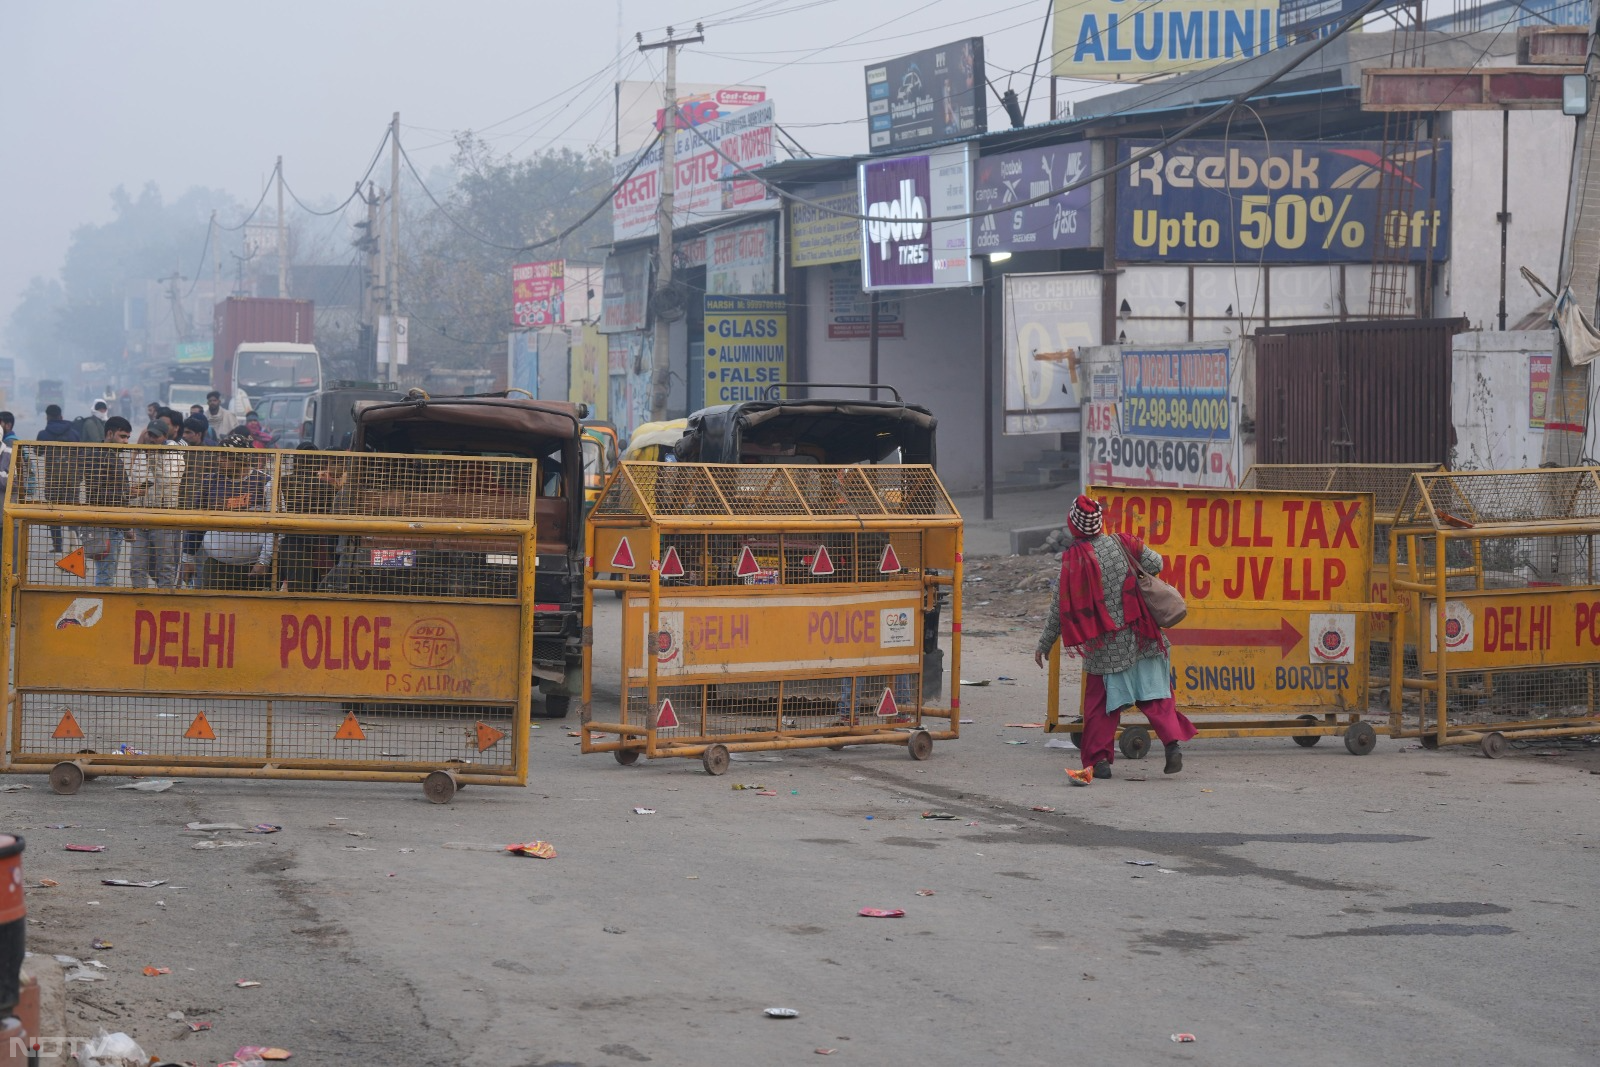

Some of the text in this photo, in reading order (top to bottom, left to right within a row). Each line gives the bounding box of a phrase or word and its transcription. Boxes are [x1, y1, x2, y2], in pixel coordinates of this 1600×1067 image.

[1001, 158, 1023, 178] Reebok
[1129, 147, 1319, 195] Reebok
[976, 188, 999, 202] campus
[868, 179, 925, 261] apollo
[1132, 209, 1220, 255] Upto
[1240, 194, 1365, 250] 50%
[977, 231, 1000, 248] adidas
[899, 244, 928, 265] TYRES
[707, 300, 734, 309] HARSH
[719, 319, 778, 338] GLASS
[719, 345, 784, 362] ALUMINIUM
[720, 367, 780, 382] FALSE
[1123, 354, 1141, 388] VIP
[1141, 354, 1180, 388] MOBILE
[1181, 352, 1227, 389] NUMBER
[720, 386, 780, 401] CEILING
[1097, 495, 1362, 549] MCD TOLL TAX
[1223, 556, 1274, 601] JV
[1282, 557, 1347, 601] LLP
[133, 609, 392, 671] DELHI POLICE
[688, 609, 876, 651] DELHI POLICE
[1484, 605, 1552, 652] DELHI
[415, 674, 472, 694] ALIPUR
[1185, 665, 1255, 691] SINGHU
[1275, 665, 1350, 690] BORDER
